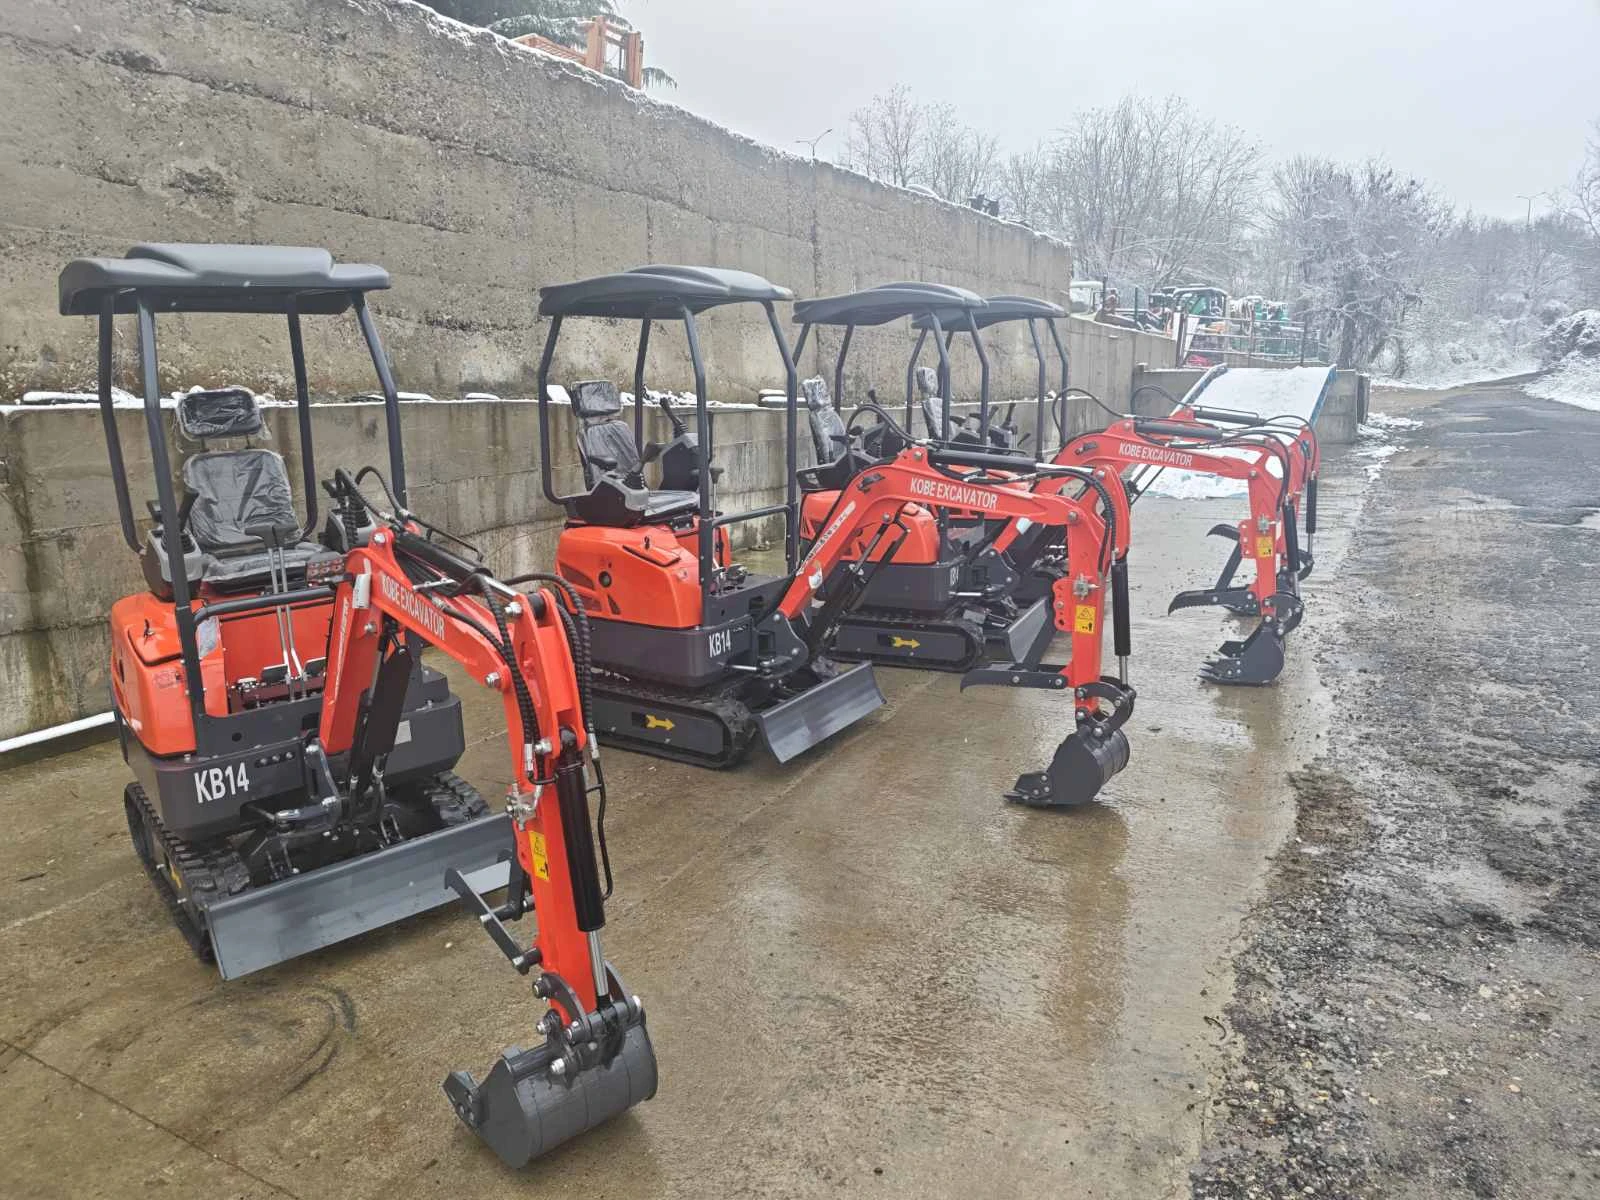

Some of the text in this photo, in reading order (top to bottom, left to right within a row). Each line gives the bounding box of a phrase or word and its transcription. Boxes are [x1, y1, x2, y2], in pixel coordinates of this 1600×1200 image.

[1119, 442, 1193, 466] KOBE EXCAVATOR
[910, 477, 997, 509] KOBE EXCAVATOR
[381, 573, 445, 640] KOBE EXCAVATOR
[709, 629, 731, 658] KB14
[194, 761, 250, 803] KB14
